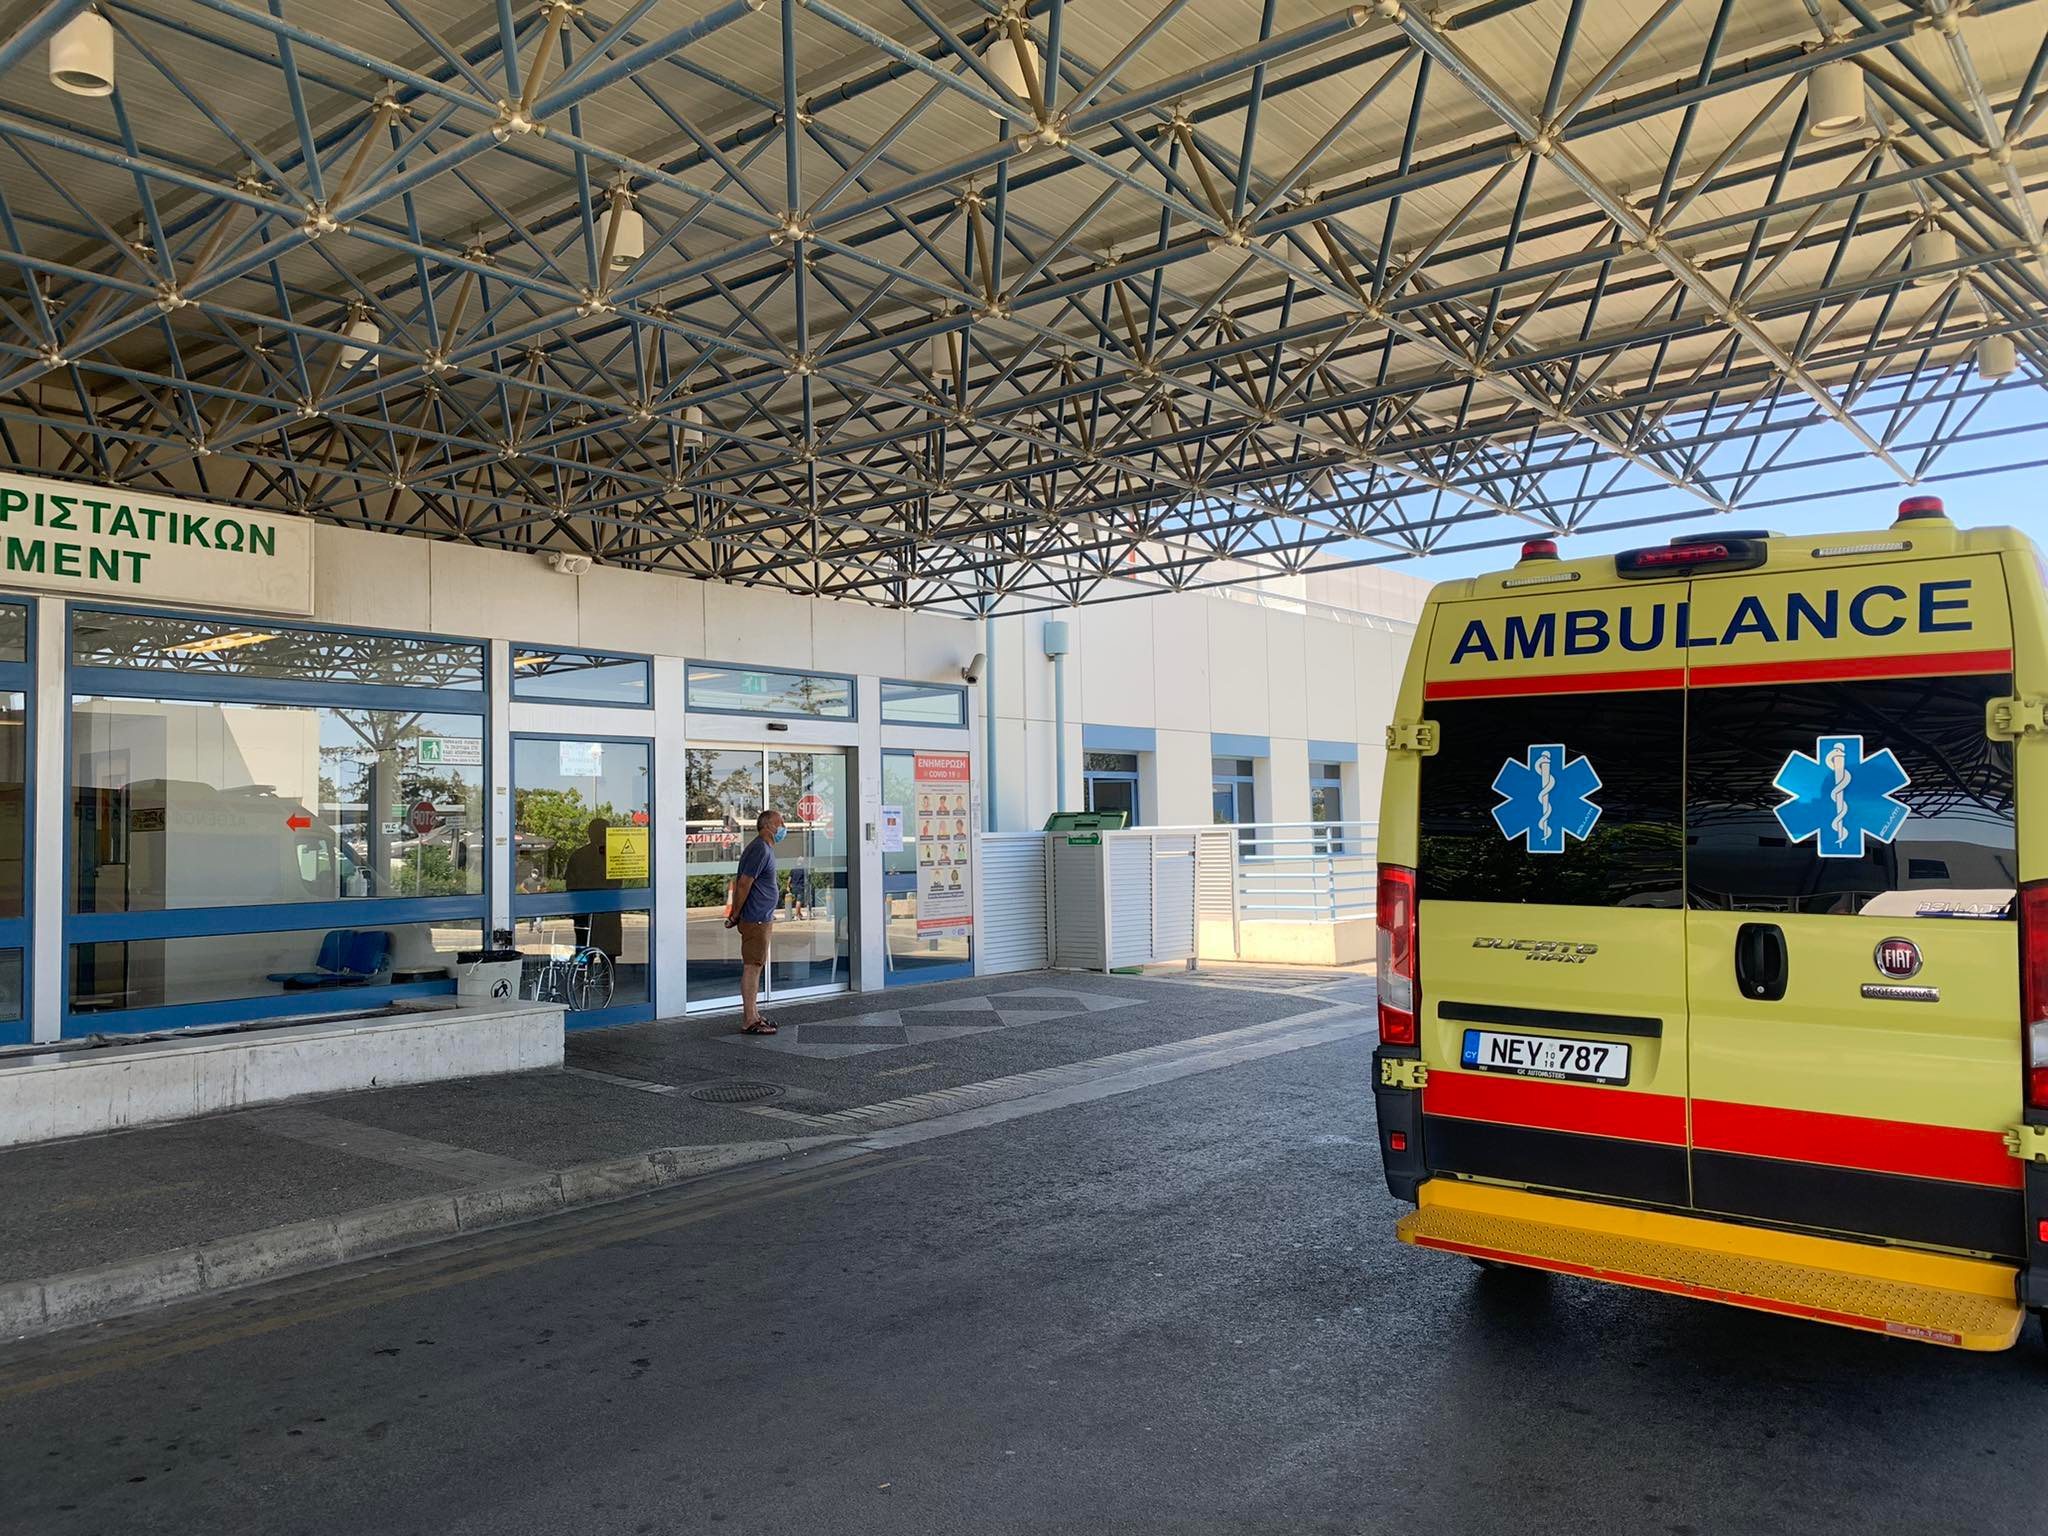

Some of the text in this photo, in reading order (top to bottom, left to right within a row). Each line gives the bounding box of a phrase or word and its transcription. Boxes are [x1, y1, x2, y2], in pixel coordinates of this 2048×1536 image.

[0, 535, 151, 583] MENT
[1449, 579, 1972, 664] AMBULANCE
[918, 758, 966, 769] ΕΝΗΜΕΡΩΣΗ
[928, 770, 948, 779] COVID
[1472, 937, 1599, 955] DUCATO
[1524, 951, 1588, 964] MAXI
[1885, 949, 1912, 969] FIAT
[1464, 1051, 1478, 1059] CY
[1490, 1037, 1610, 1073] NEY 787
